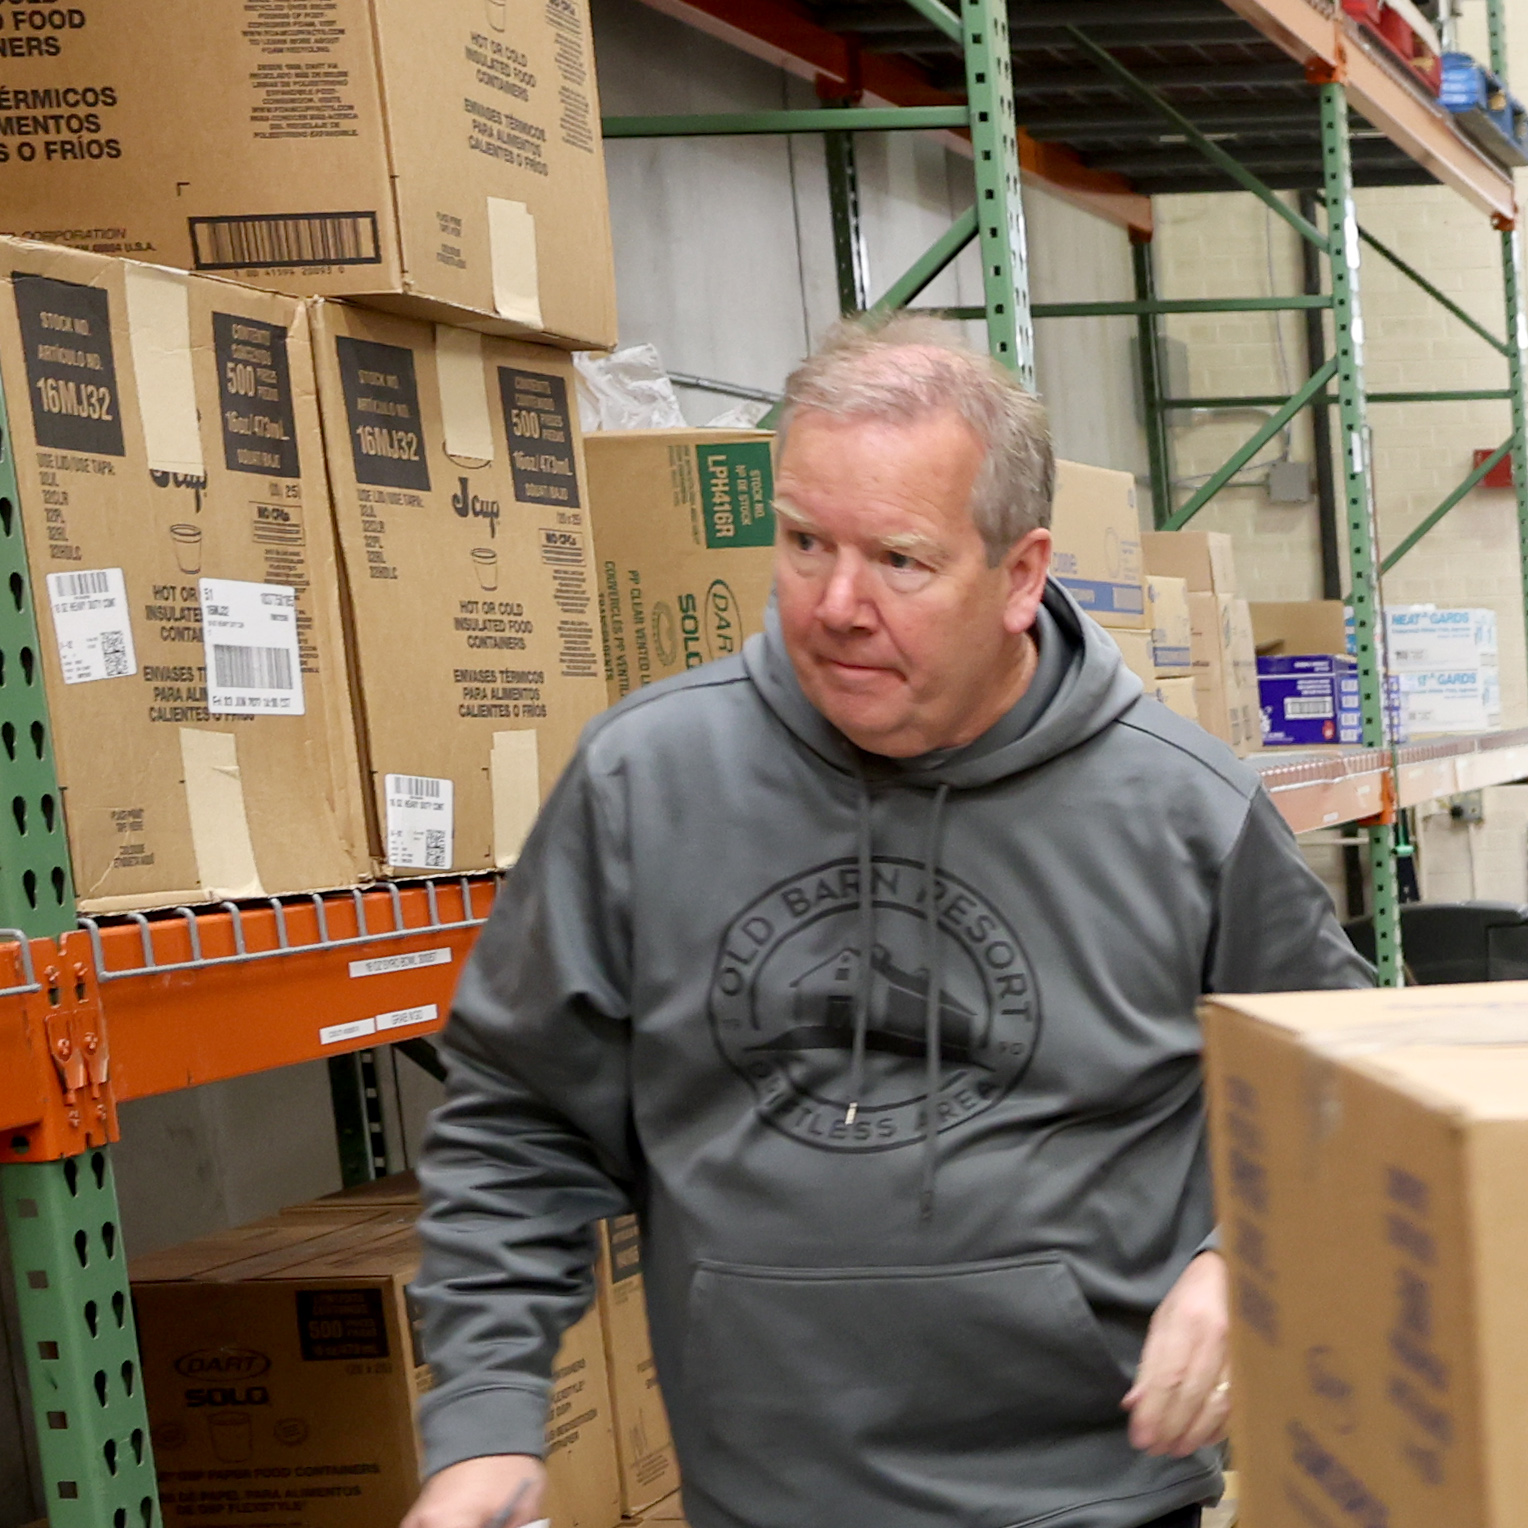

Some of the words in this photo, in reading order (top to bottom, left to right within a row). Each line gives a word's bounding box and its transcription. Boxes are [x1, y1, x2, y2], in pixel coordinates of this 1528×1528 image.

[12, 9, 86, 31] FOOD
[17, 142, 35, 161] O
[44, 135, 122, 160] FRÍOS
[226, 361, 255, 398] 500
[36, 376, 113, 421] 16MJ32
[511, 409, 540, 439] 500
[356, 425, 420, 461] 16MJ32
[452, 476, 470, 518] J
[707, 454, 736, 538] LPH416R
[460, 601, 479, 615] HOT
[498, 602, 523, 617] COLD
[508, 620, 533, 634] FOOD
[717, 917, 775, 998] OLD
[781, 869, 900, 918] BARN
[916, 880, 1033, 1022] RESORT
[187, 1356, 257, 1373] DART
[185, 1386, 269, 1408] SOLO
